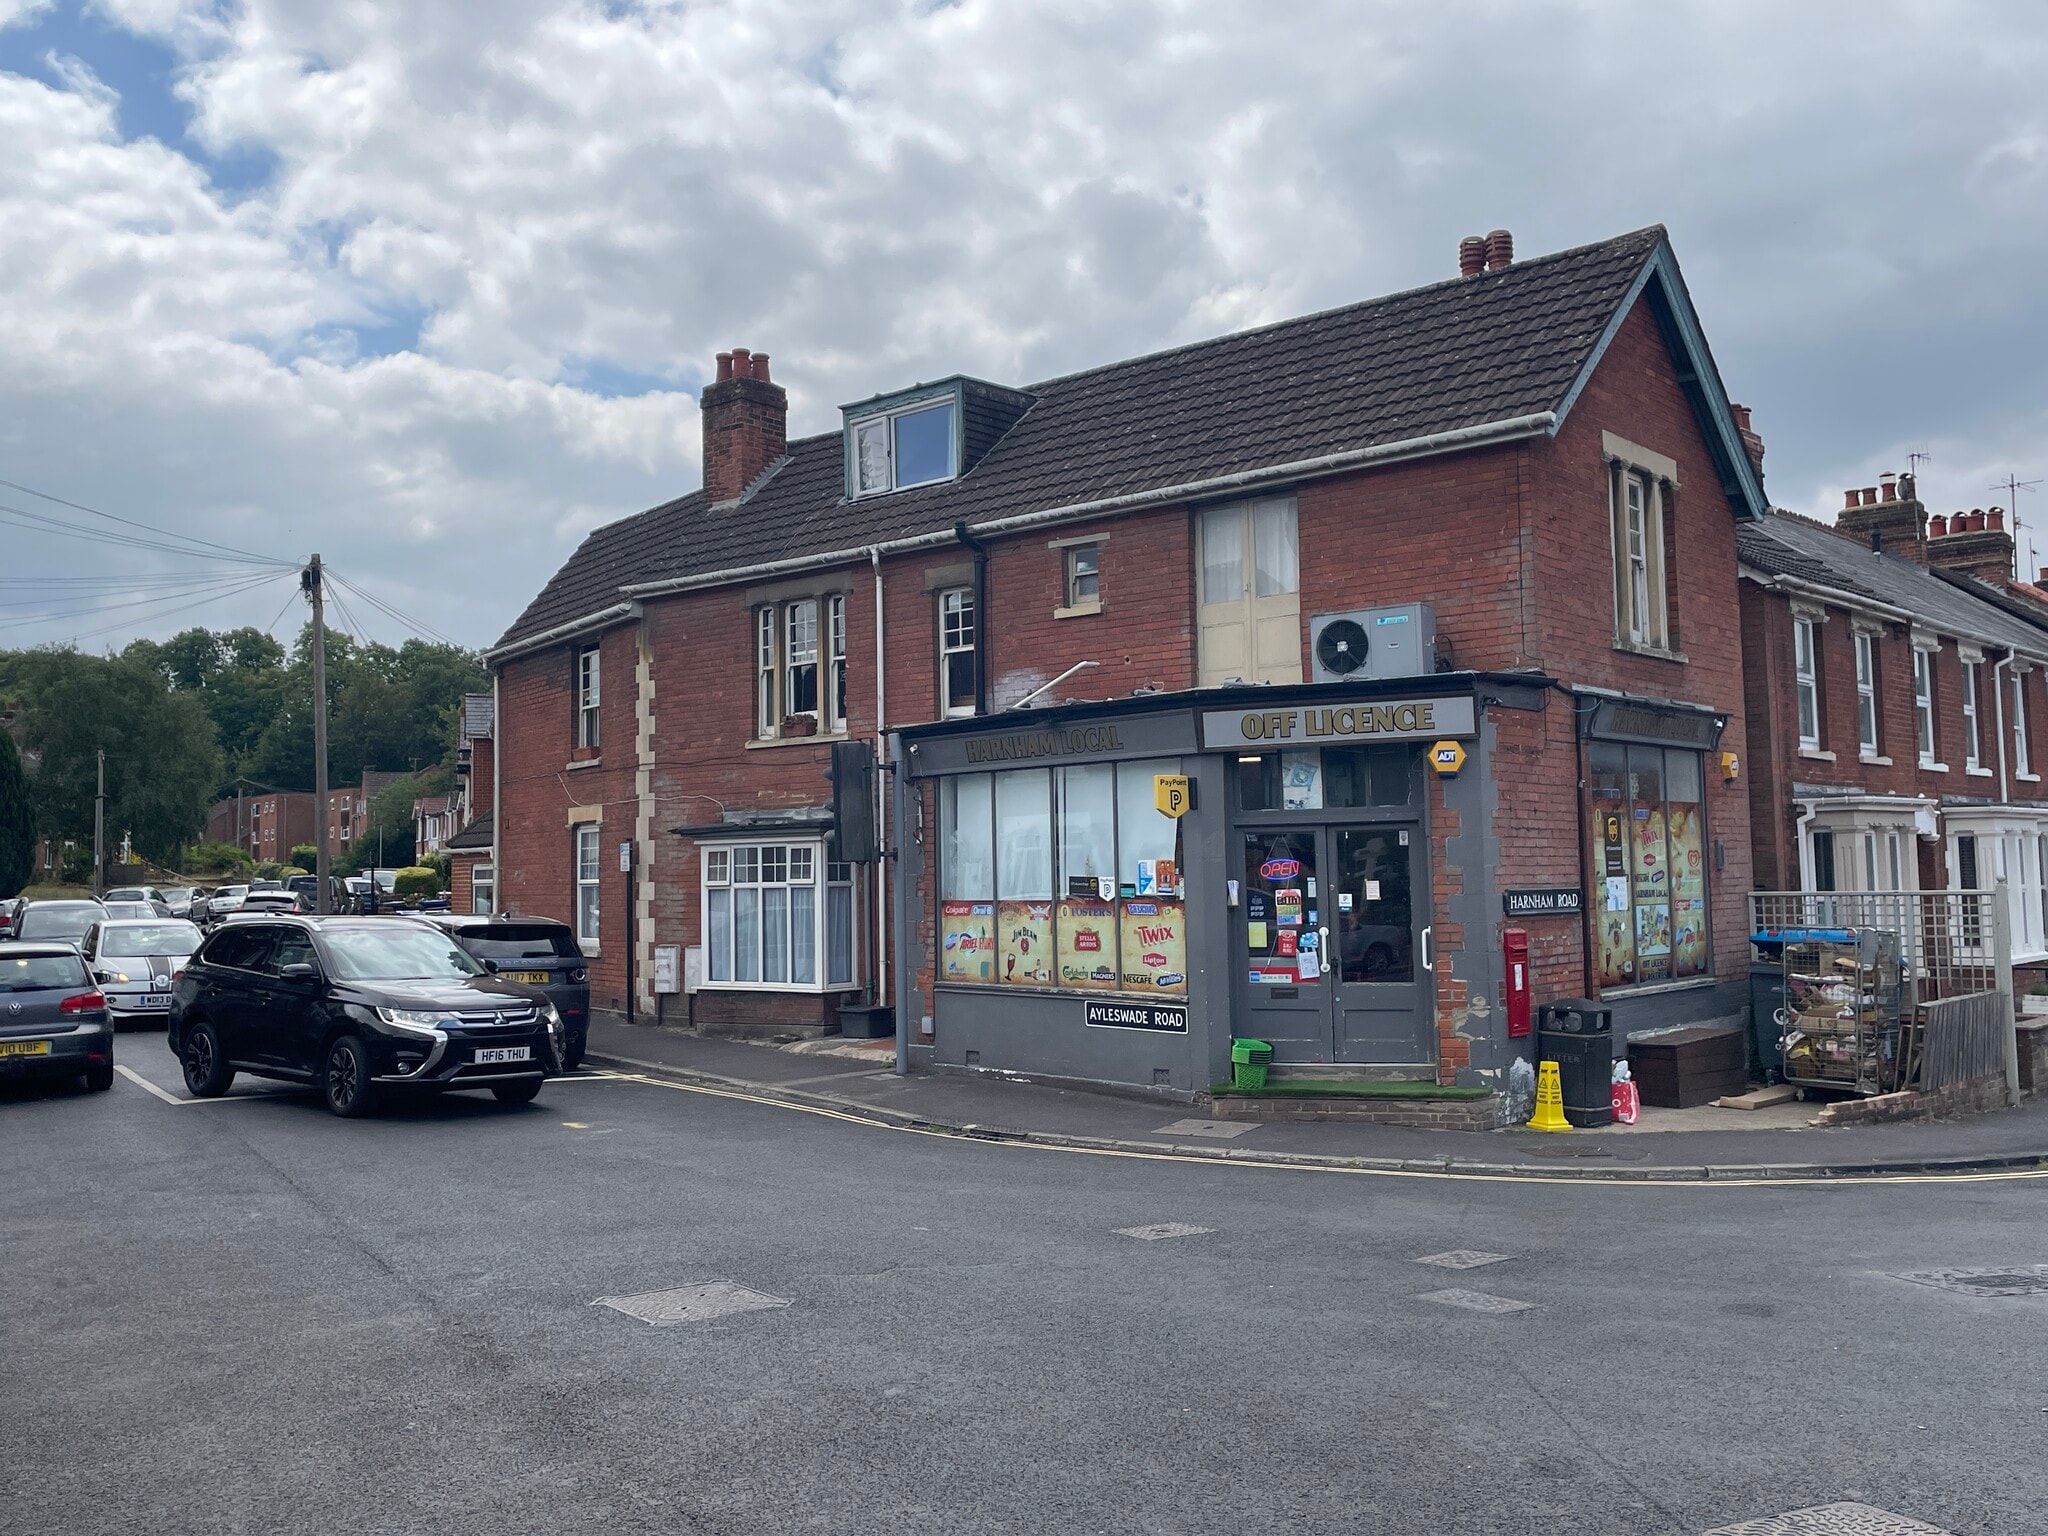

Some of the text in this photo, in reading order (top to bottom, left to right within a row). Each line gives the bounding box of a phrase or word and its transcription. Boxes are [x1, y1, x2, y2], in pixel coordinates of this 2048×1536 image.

[1241, 703, 1435, 740] OFF LICENCE
[965, 725, 1124, 763] HARNHAM LOCAL
[1438, 751, 1456, 762] ADT
[1160, 778, 1187, 788] PayPoint
[1260, 861, 1300, 878] OPEN
[1510, 893, 1578, 910] HARNHAM ROAD
[945, 905, 970, 914] Colgate
[1144, 956, 1165, 966] Lipton
[527, 972, 544, 982] TKX
[1062, 966, 1089, 981] Carlsberg
[1089, 1007, 1183, 1027] AYLESWADE ROAD
[18, 1041, 41, 1053] UBF
[481, 1048, 525, 1062] HF16 THU
[1547, 1053, 1580, 1063] LITTER
